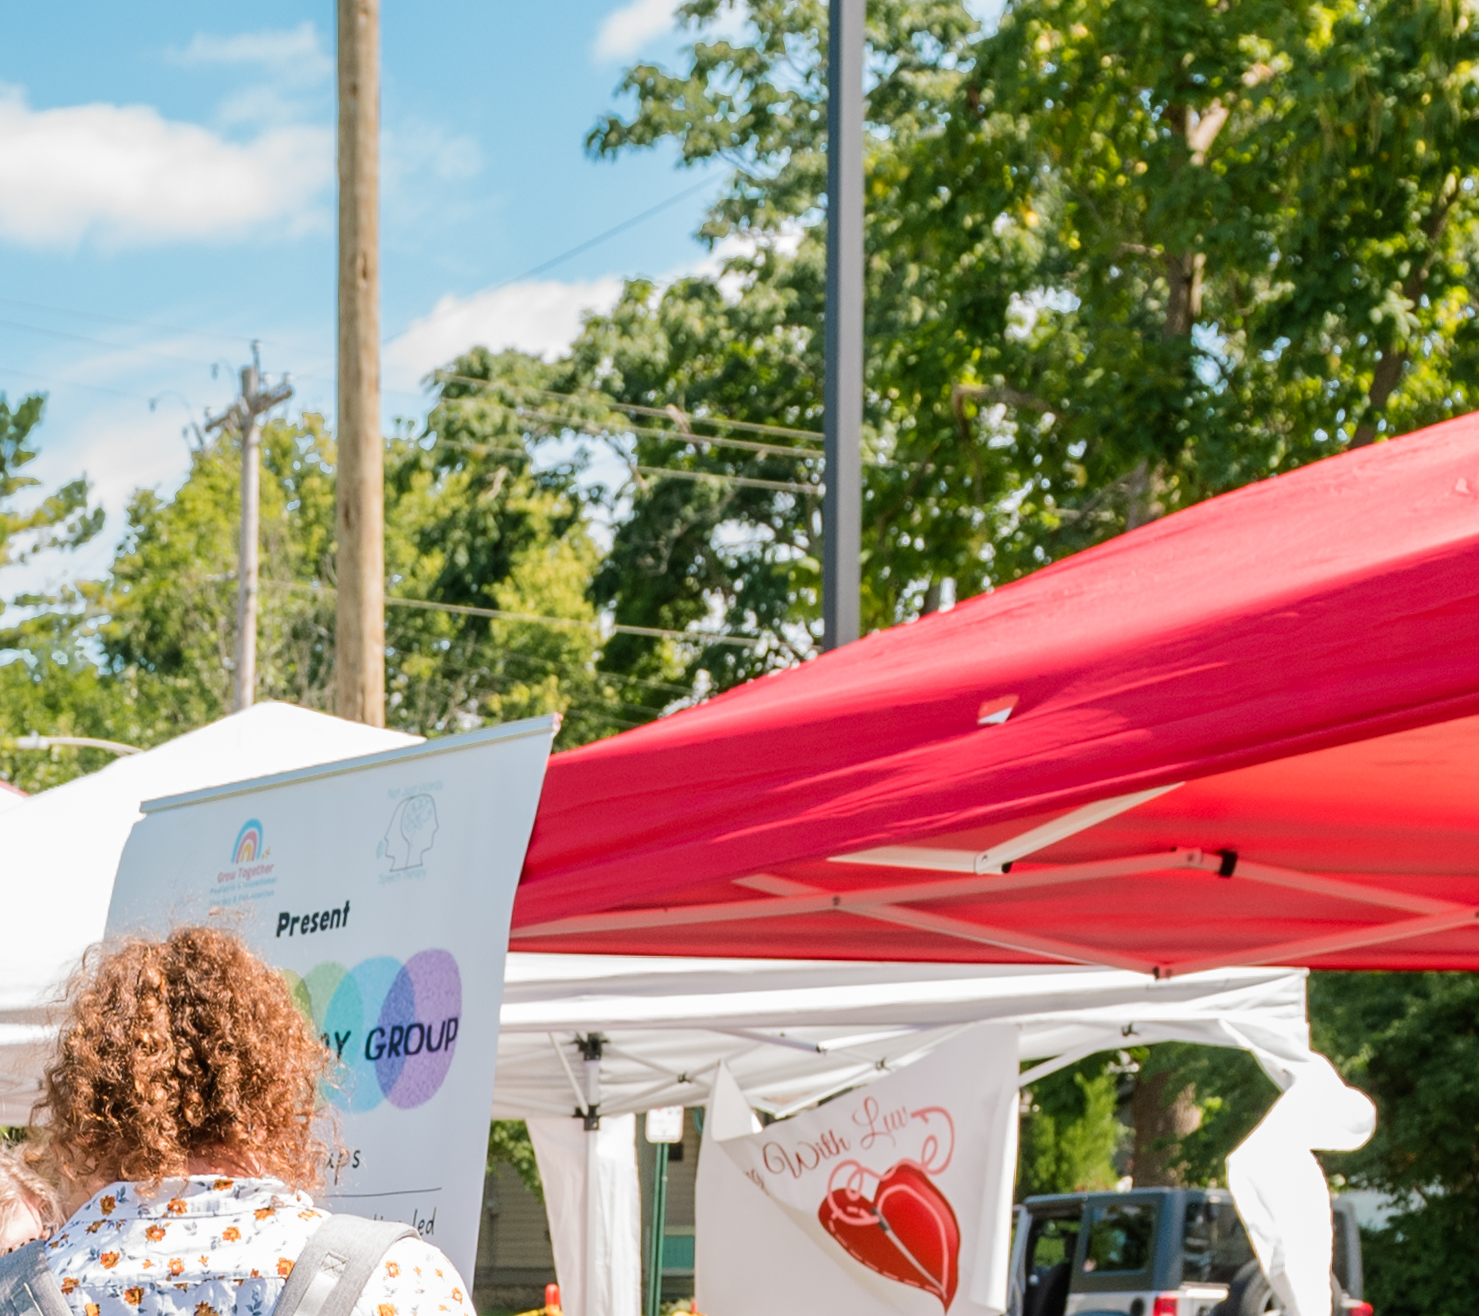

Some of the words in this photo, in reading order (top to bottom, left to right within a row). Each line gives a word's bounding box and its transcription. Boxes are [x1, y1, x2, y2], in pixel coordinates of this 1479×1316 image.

[276, 900, 351, 938] Present
[364, 1016, 459, 1062] GROUP
[762, 1129, 851, 1179] With
